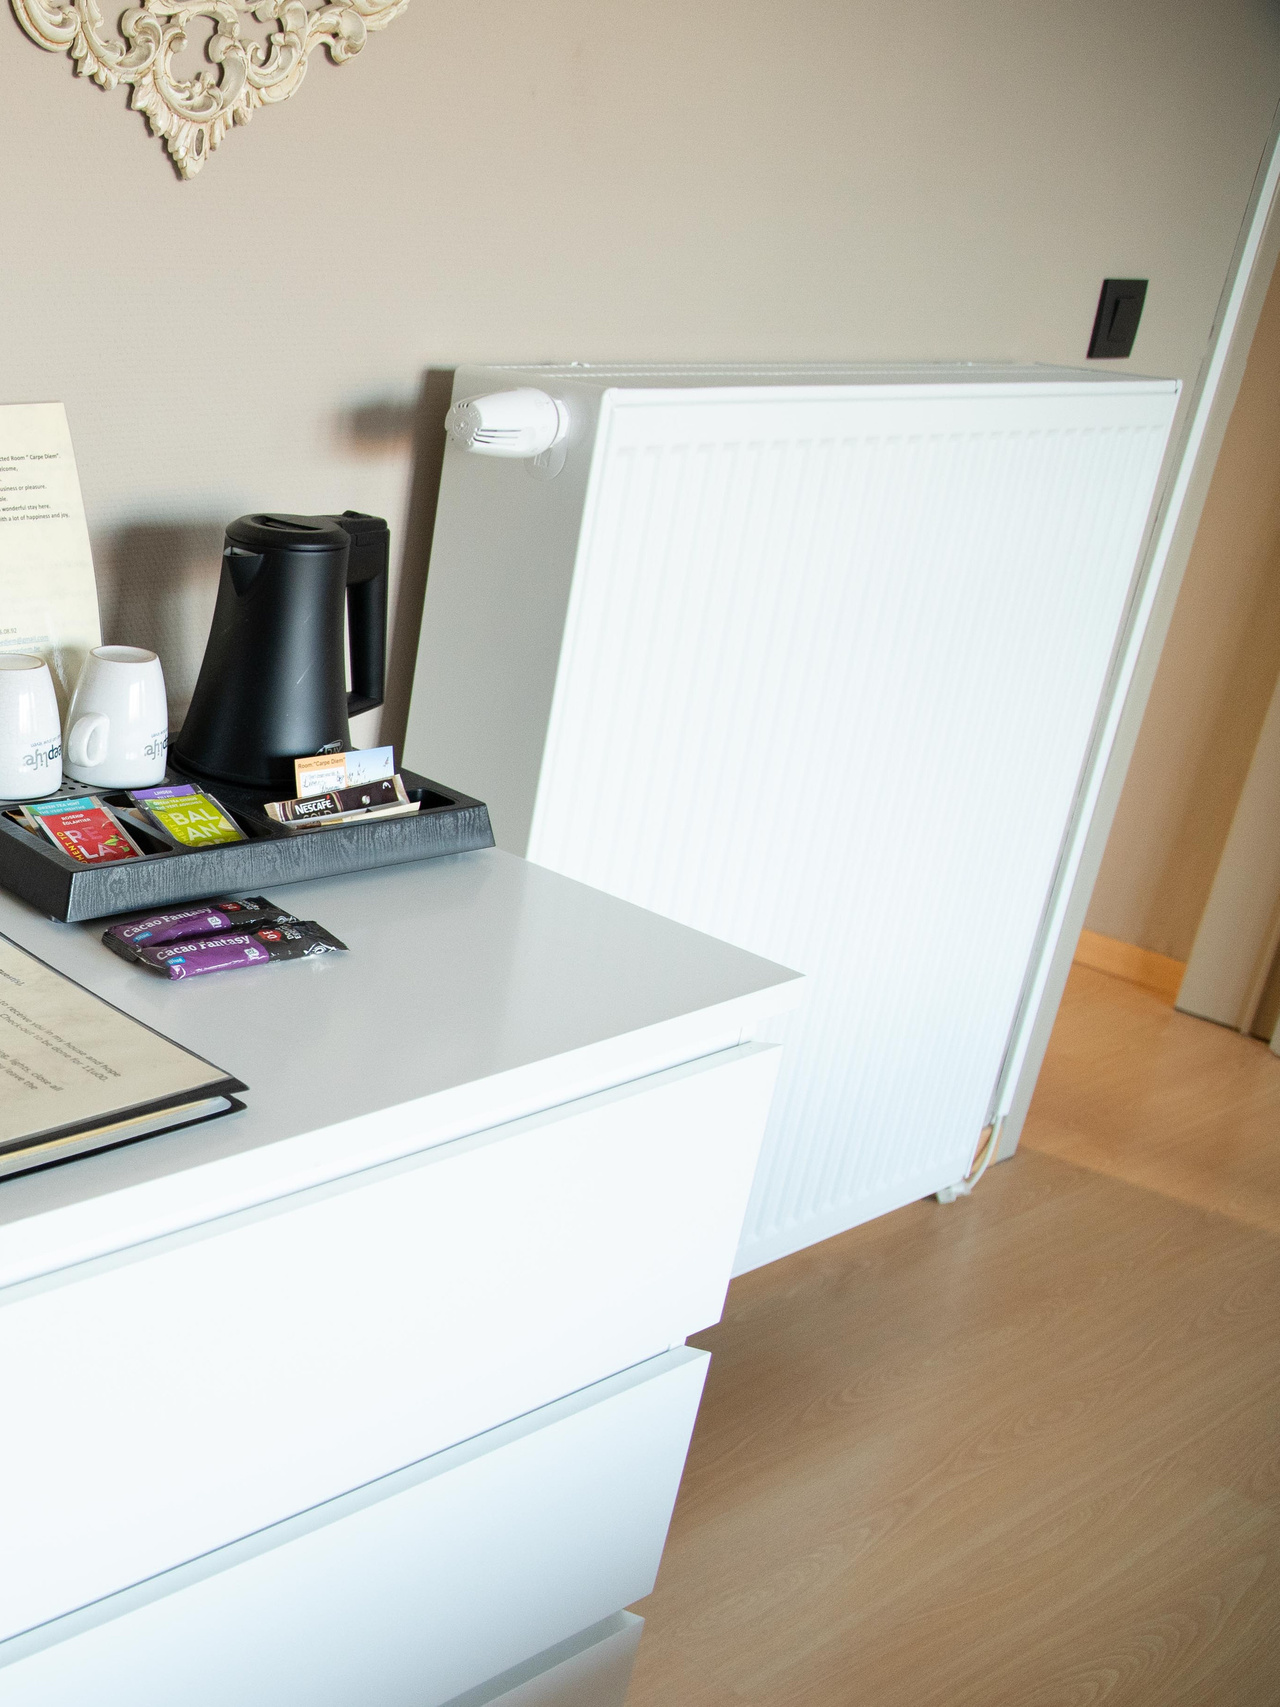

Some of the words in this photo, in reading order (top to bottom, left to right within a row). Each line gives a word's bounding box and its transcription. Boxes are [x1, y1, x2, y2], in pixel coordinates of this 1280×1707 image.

[294, 795, 334, 815] NESCAFÉ
[168, 808, 219, 825] BAL
[64, 826, 103, 844] RE
[187, 823, 222, 841] AN
[122, 917, 162, 938] Cacao
[162, 905, 213, 926] Fantasy
[156, 943, 197, 961] Cacao
[199, 934, 252, 950] Fantasy
[167, 957, 184, 966] Blue
